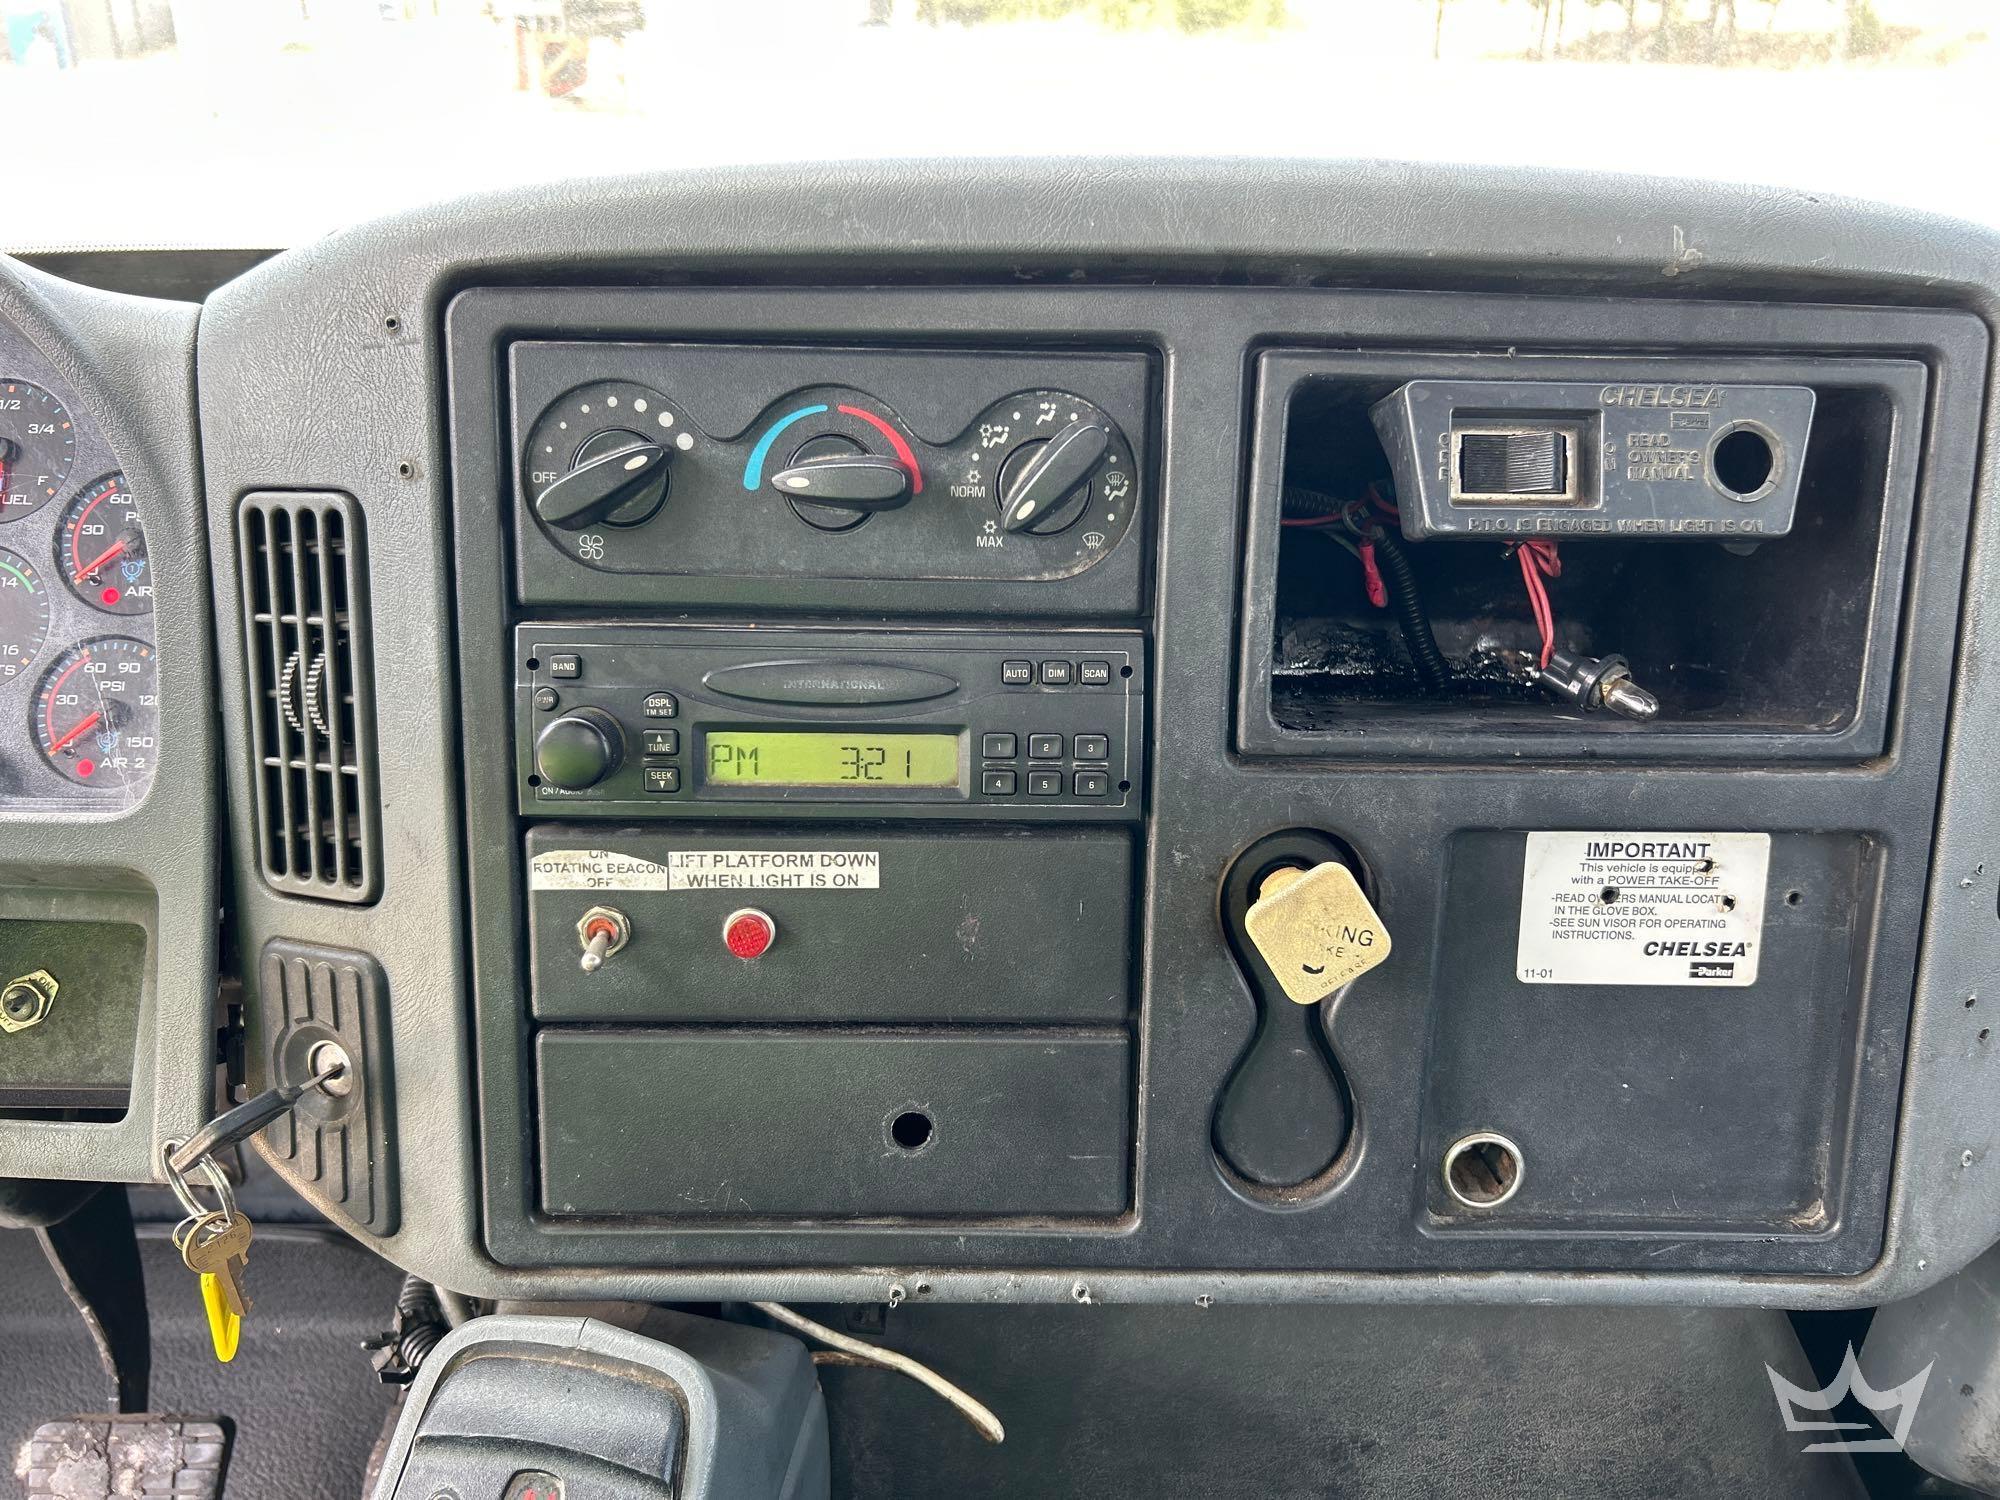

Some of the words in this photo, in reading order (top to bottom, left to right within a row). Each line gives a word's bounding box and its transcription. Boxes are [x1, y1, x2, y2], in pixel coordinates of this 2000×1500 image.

[1600, 385, 1721, 408] CHELSEA
[28, 423, 55, 434] 3/4
[1628, 434, 1671, 447] READ
[533, 471, 557, 483] OFF
[1628, 466, 1695, 480] MANUAL
[38, 475, 48, 485] F
[951, 486, 985, 498] NORM
[0, 495, 33, 505] UEL
[109, 494, 132, 504] 60
[82, 525, 104, 535] 30
[1536, 519, 1613, 532] ENGAGED
[1617, 519, 1665, 532] WHEN
[1670, 519, 1714, 532] LIGHT
[1720, 519, 1736, 532] IS
[1740, 519, 1763, 532] ON
[976, 536, 1003, 548] MAX
[1, 577, 18, 588] 14
[2, 645, 19, 655] 16
[84, 662, 106, 673] 60
[118, 662, 140, 673] 90
[552, 662, 576, 671] BAND
[1005, 669, 1028, 678] AUTO
[1048, 669, 1065, 678] DIM
[1084, 669, 1107, 678] SCAN
[100, 681, 125, 691] PSI
[56, 695, 78, 705] 30
[648, 698, 671, 707] DSPL
[126, 737, 153, 747] 150
[648, 743, 671, 752] TUNE
[1043, 743, 1049, 752] 2
[1087, 743, 1094, 752] 3
[100, 758, 127, 768] AIR
[134, 758, 145, 768] 2
[711, 744, 759, 775] PM
[840, 747, 911, 780] 3:21
[650, 771, 673, 780] SEEK
[995, 780, 1002, 788] 4
[1042, 780, 1048, 789] 5
[1088, 780, 1095, 789] 6
[1586, 841, 1711, 858] IMPORTANT
[589, 851, 608, 859] ON
[670, 854, 708, 868] LIFT
[713, 854, 814, 868] PLATFORM
[820, 854, 877, 868] DOWN
[534, 862, 602, 873] ROTATING
[607, 863, 666, 874] BEACON
[1580, 863, 1604, 873] This
[1606, 863, 1646, 873] vehicle
[1649, 863, 1659, 873] is
[1662, 864, 1702, 876] equipp
[587, 877, 614, 887] OFF
[687, 874, 743, 888] WHEN
[749, 874, 804, 887] LIGHT
[810, 874, 827, 887] IS
[833, 874, 859, 887] ON
[1571, 876, 1594, 885] with
[1597, 877, 1604, 885] a
[1607, 876, 1655, 885] POWER
[1659, 876, 1720, 886] TAKE-OFF
[1587, 894, 1636, 904] OERS
[1638, 894, 1684, 904] MANUAL
[1685, 895, 1721, 904] LOCAT
[1554, 906, 1566, 915] IN
[1568, 906, 1590, 915] THE
[1592, 906, 1630, 916] GLOVE
[1632, 906, 1658, 916] BOX.
[1577, 918, 1600, 928] SUN
[1603, 918, 1637, 928] VISOR
[1639, 919, 1661, 928] FOR
[1665, 919, 1727, 929] OPERATING
[1552, 930, 1636, 940] INSTRUCTIONS.
[1523, 969, 1554, 979] 11-01
[1697, 966, 1734, 977] Parker
